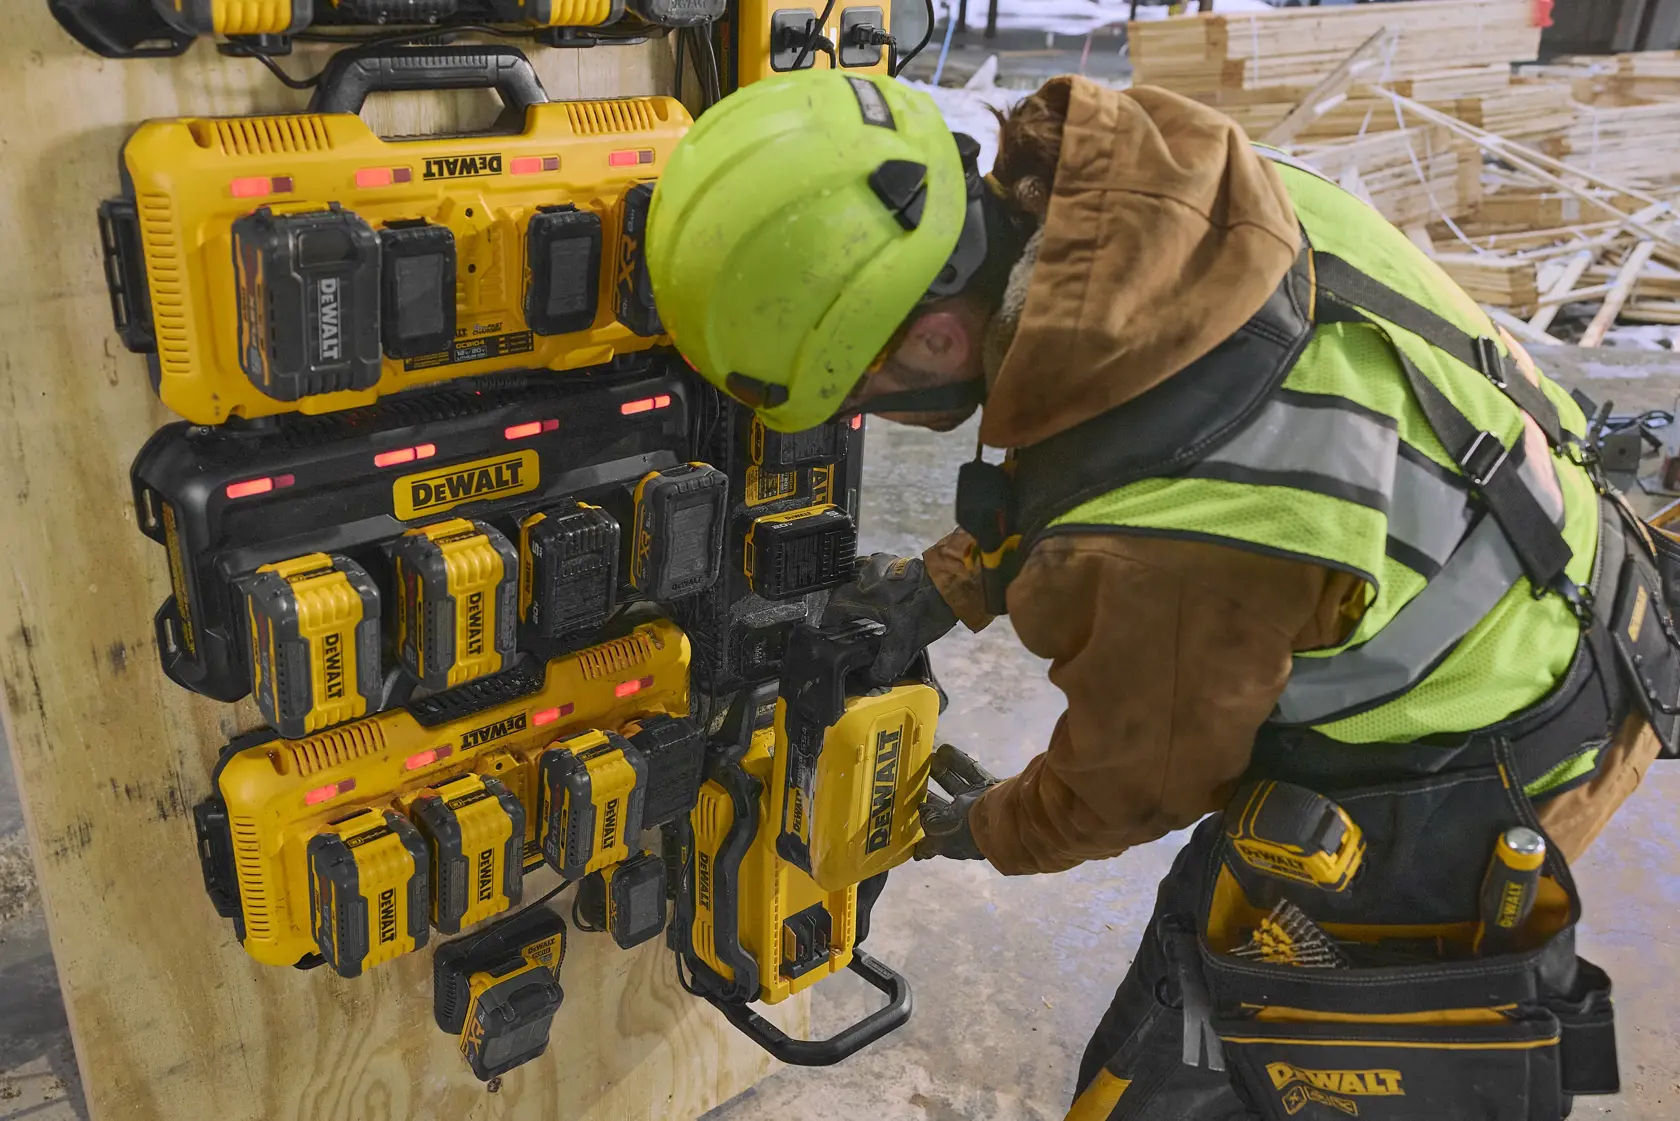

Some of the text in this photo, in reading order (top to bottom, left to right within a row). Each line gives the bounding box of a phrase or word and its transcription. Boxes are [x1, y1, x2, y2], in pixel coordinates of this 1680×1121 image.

[423, 156, 502, 178] DEWALT
[618, 234, 637, 294] XR
[320, 278, 339, 359] DEWALT
[412, 461, 524, 507] DEWALT
[468, 591, 482, 655] DEWALT
[325, 633, 343, 699] DEWALT
[461, 714, 526, 750] DEWALT
[868, 729, 900, 853] DEWALT
[603, 798, 618, 850] DEWALT
[479, 848, 493, 902] DEWALT
[700, 850, 711, 912] DEWALT
[381, 888, 394, 945] DEWALT
